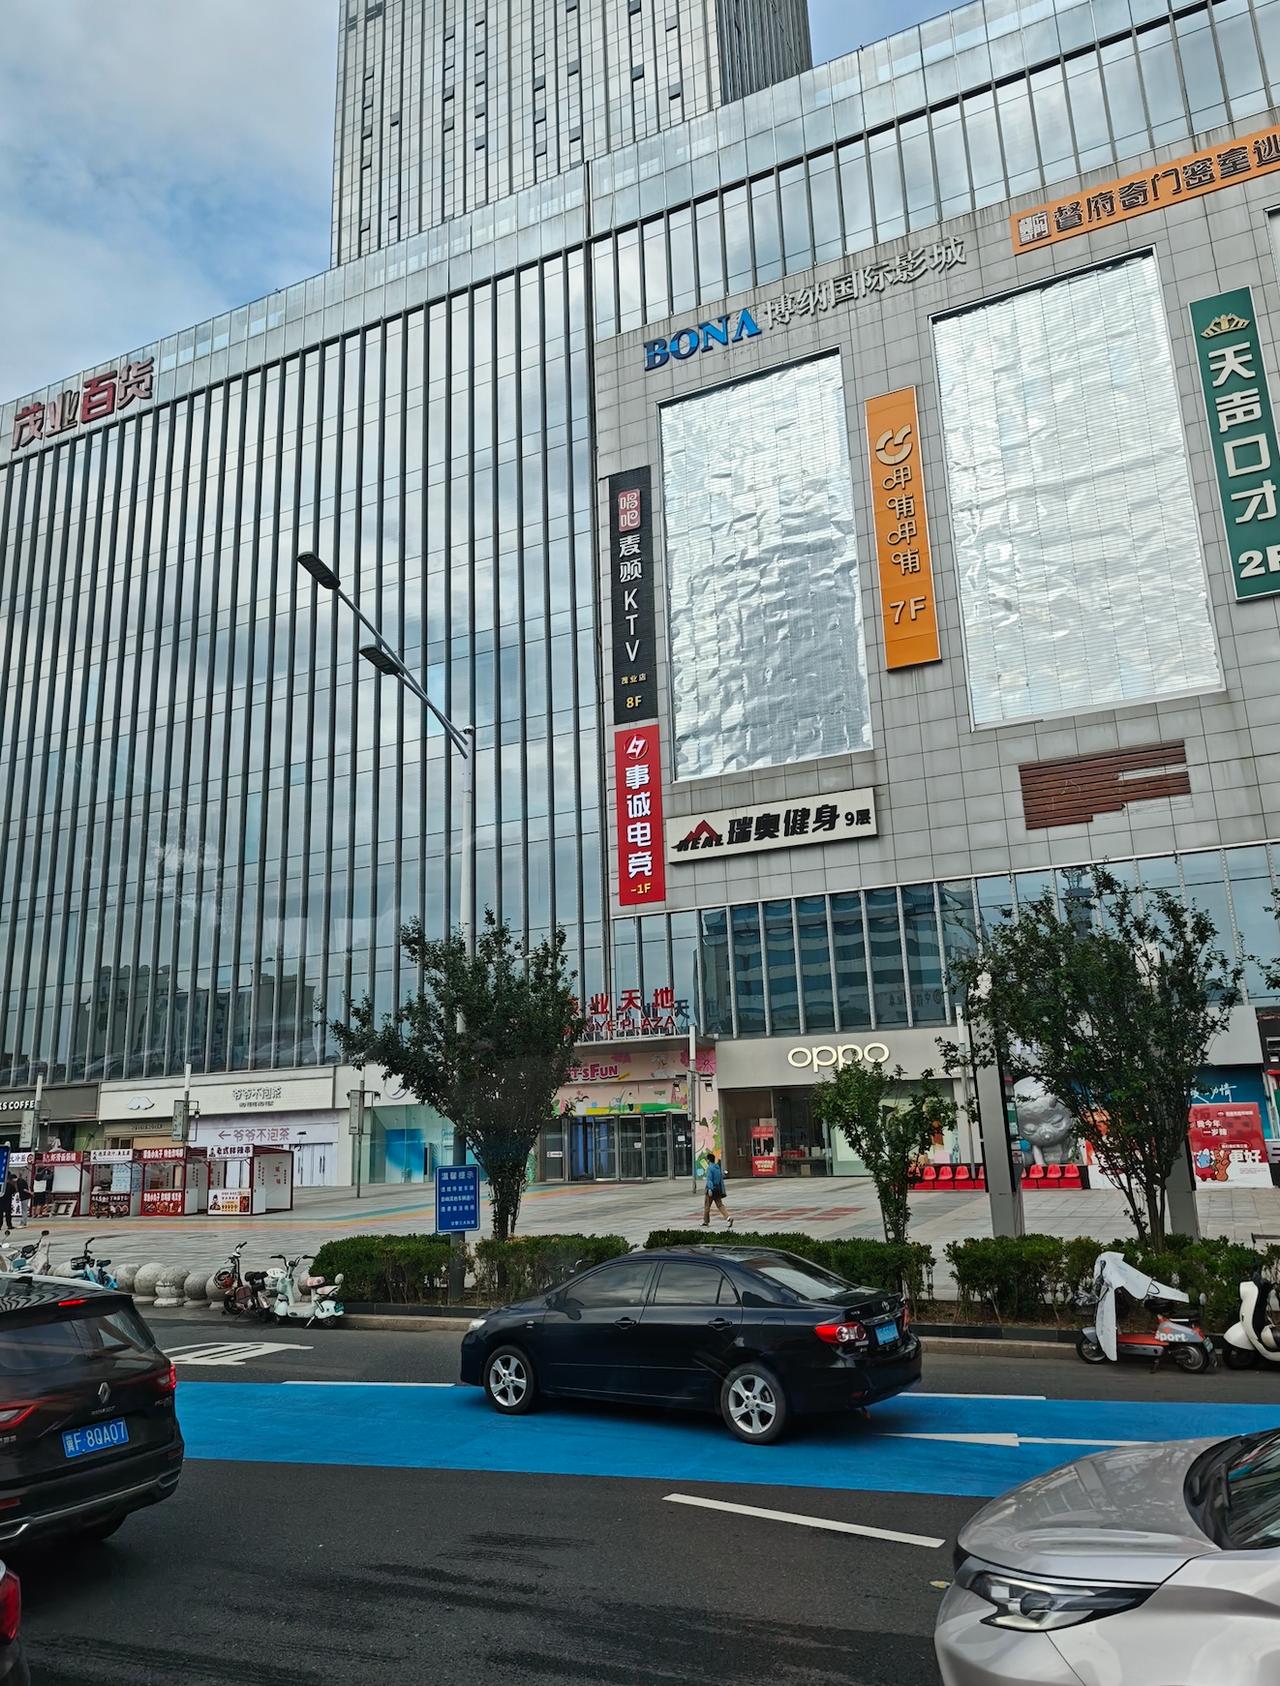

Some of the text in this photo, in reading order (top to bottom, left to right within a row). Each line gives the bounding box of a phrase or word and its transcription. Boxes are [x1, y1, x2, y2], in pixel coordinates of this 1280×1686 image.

[643, 236, 967, 371] BONA 博纳国际影城
[11, 356, 154, 451] 茂业百货
[1207, 341, 1278, 524] 天声口才
[882, 465, 921, 576] 呷哺呷哺
[889, 595, 927, 625] 7F
[626, 695, 643, 709] 8F
[625, 764, 653, 879] 事诚电竞
[726, 804, 840, 845] 瑞奥健身
[844, 808, 872, 827] 9层
[233, 1128, 290, 1142] 爷爷不泡茶
